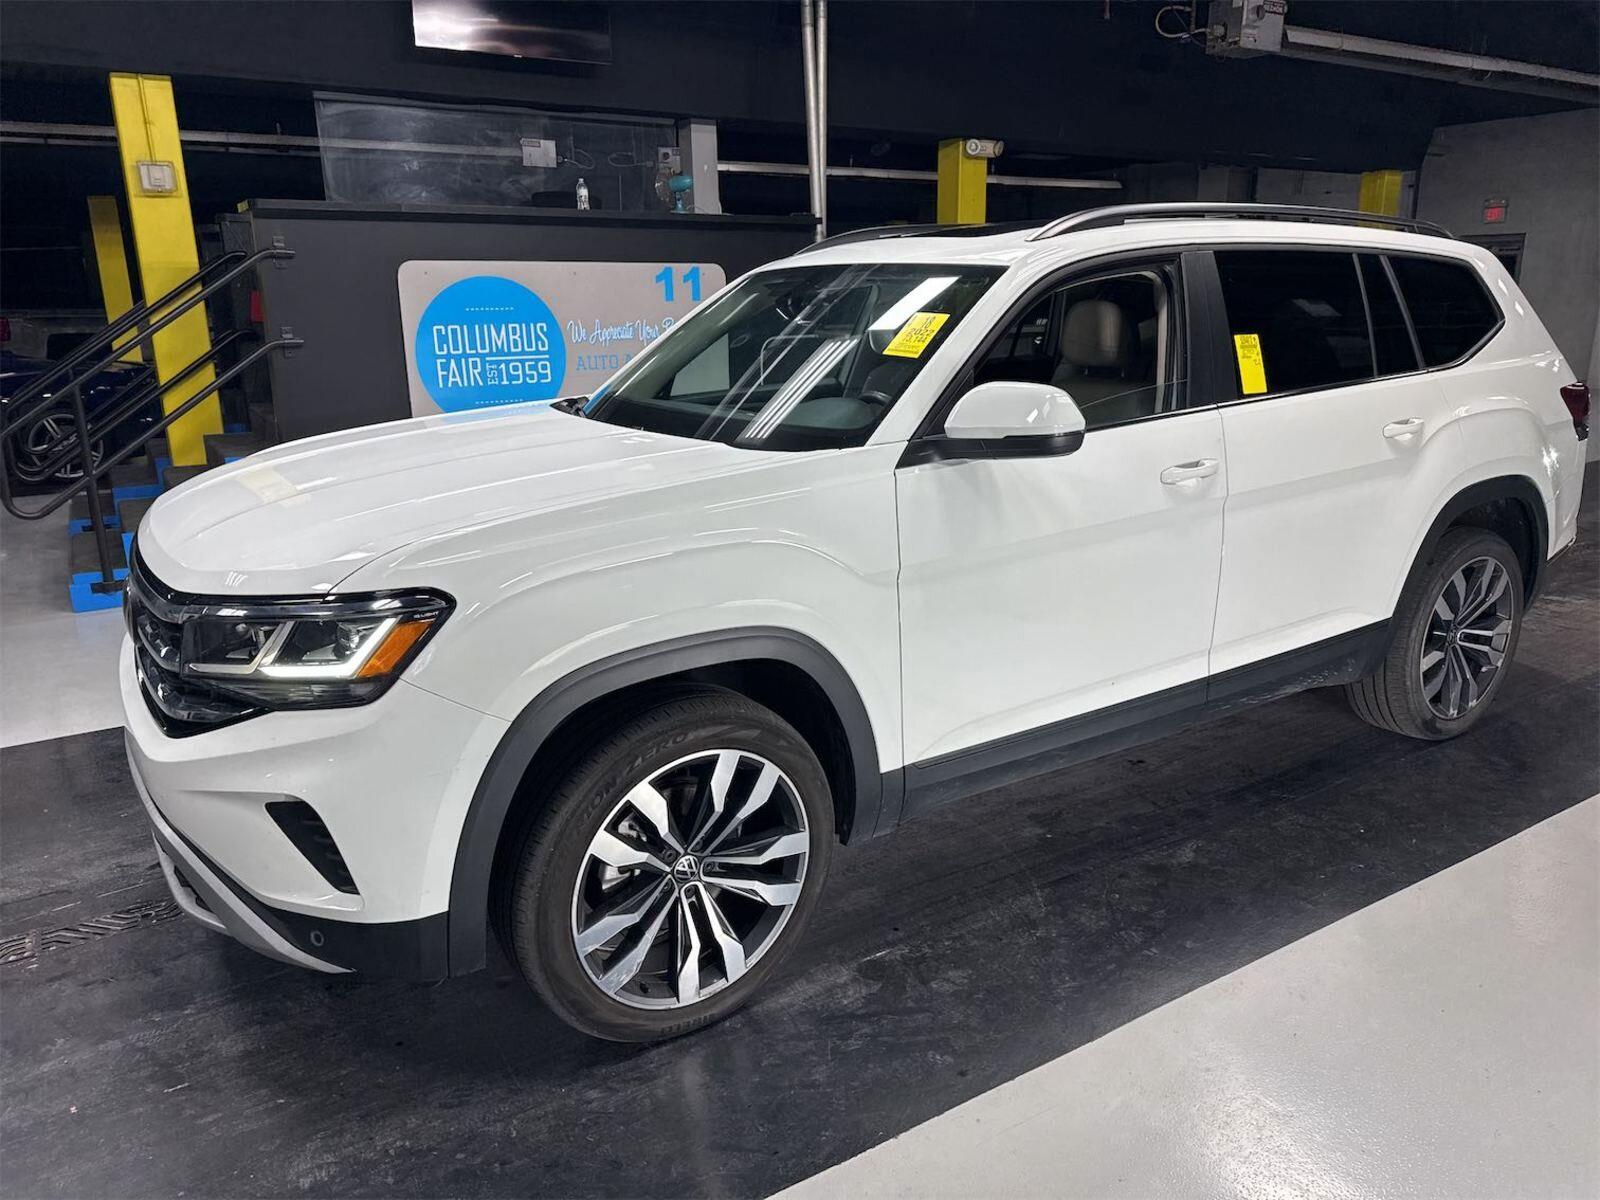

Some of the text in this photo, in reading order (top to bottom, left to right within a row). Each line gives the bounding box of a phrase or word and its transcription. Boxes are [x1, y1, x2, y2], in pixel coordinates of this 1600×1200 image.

[655, 266, 701, 302] 11
[432, 322, 549, 355] COLUMBUS
[567, 320, 587, 342] We
[589, 319, 634, 347] Appreciate
[634, 319, 659, 347] Your
[436, 357, 552, 388] FAIR EST 1959
[576, 353, 619, 370] AUTO
